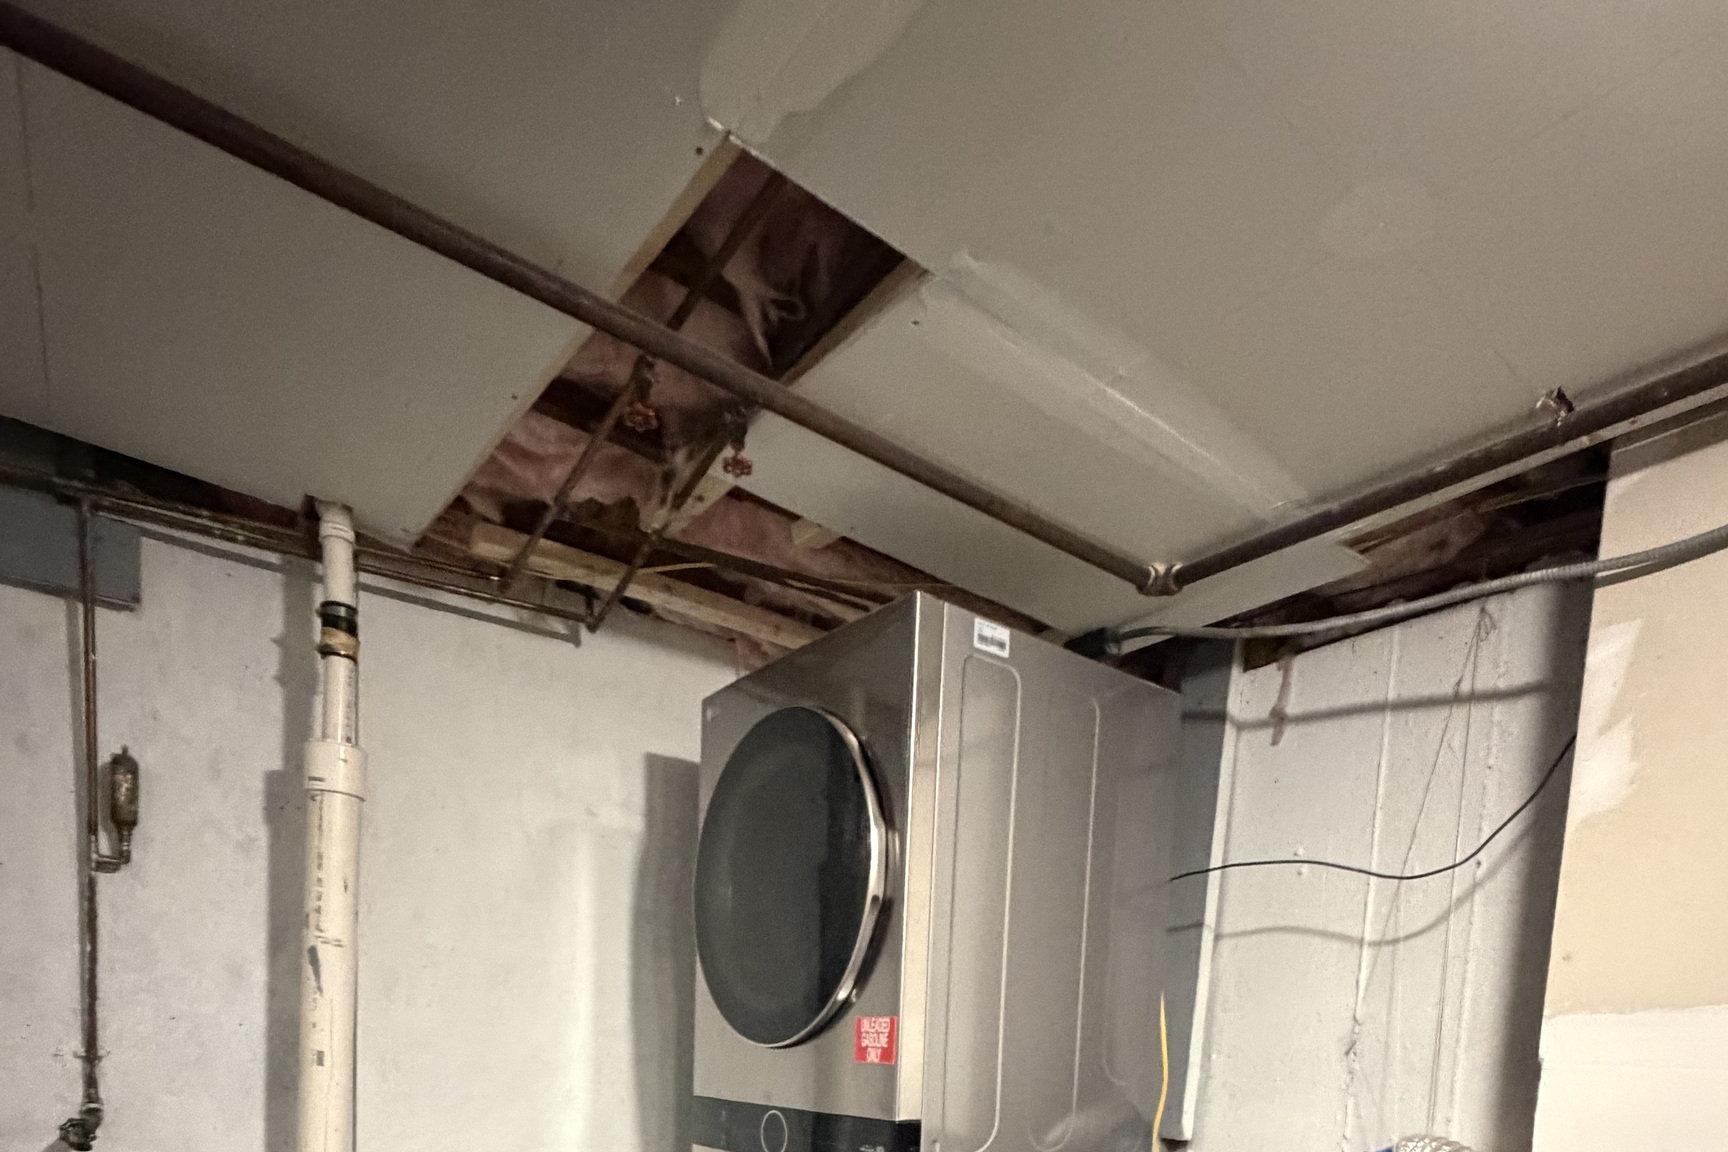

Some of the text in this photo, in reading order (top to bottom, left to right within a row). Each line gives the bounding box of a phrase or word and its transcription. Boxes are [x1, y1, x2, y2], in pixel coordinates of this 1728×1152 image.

[860, 1017, 891, 1032] UNLEADED
[861, 1032, 889, 1047] GASOLINE
[866, 1047, 882, 1062] ONLY
